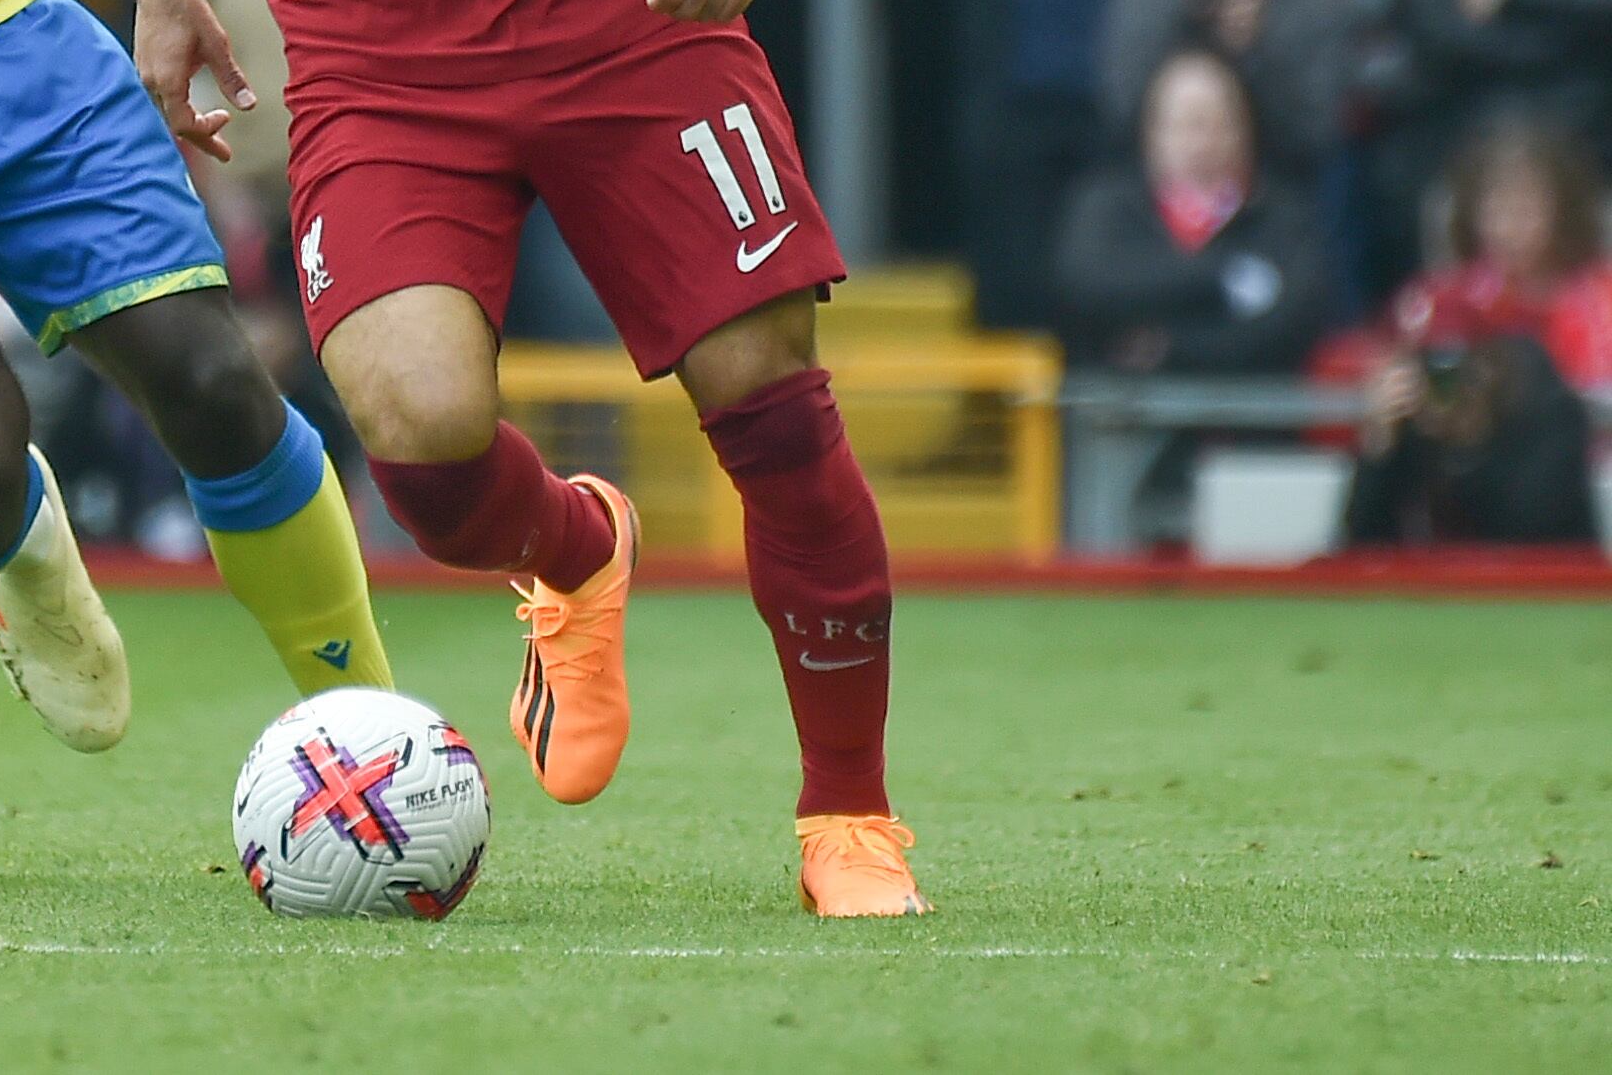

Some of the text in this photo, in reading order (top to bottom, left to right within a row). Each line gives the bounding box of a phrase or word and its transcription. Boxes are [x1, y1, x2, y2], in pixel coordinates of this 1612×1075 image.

[679, 103, 787, 231] 11
[405, 788, 438, 809] NIKE
[441, 775, 475, 799] FLIGHT
